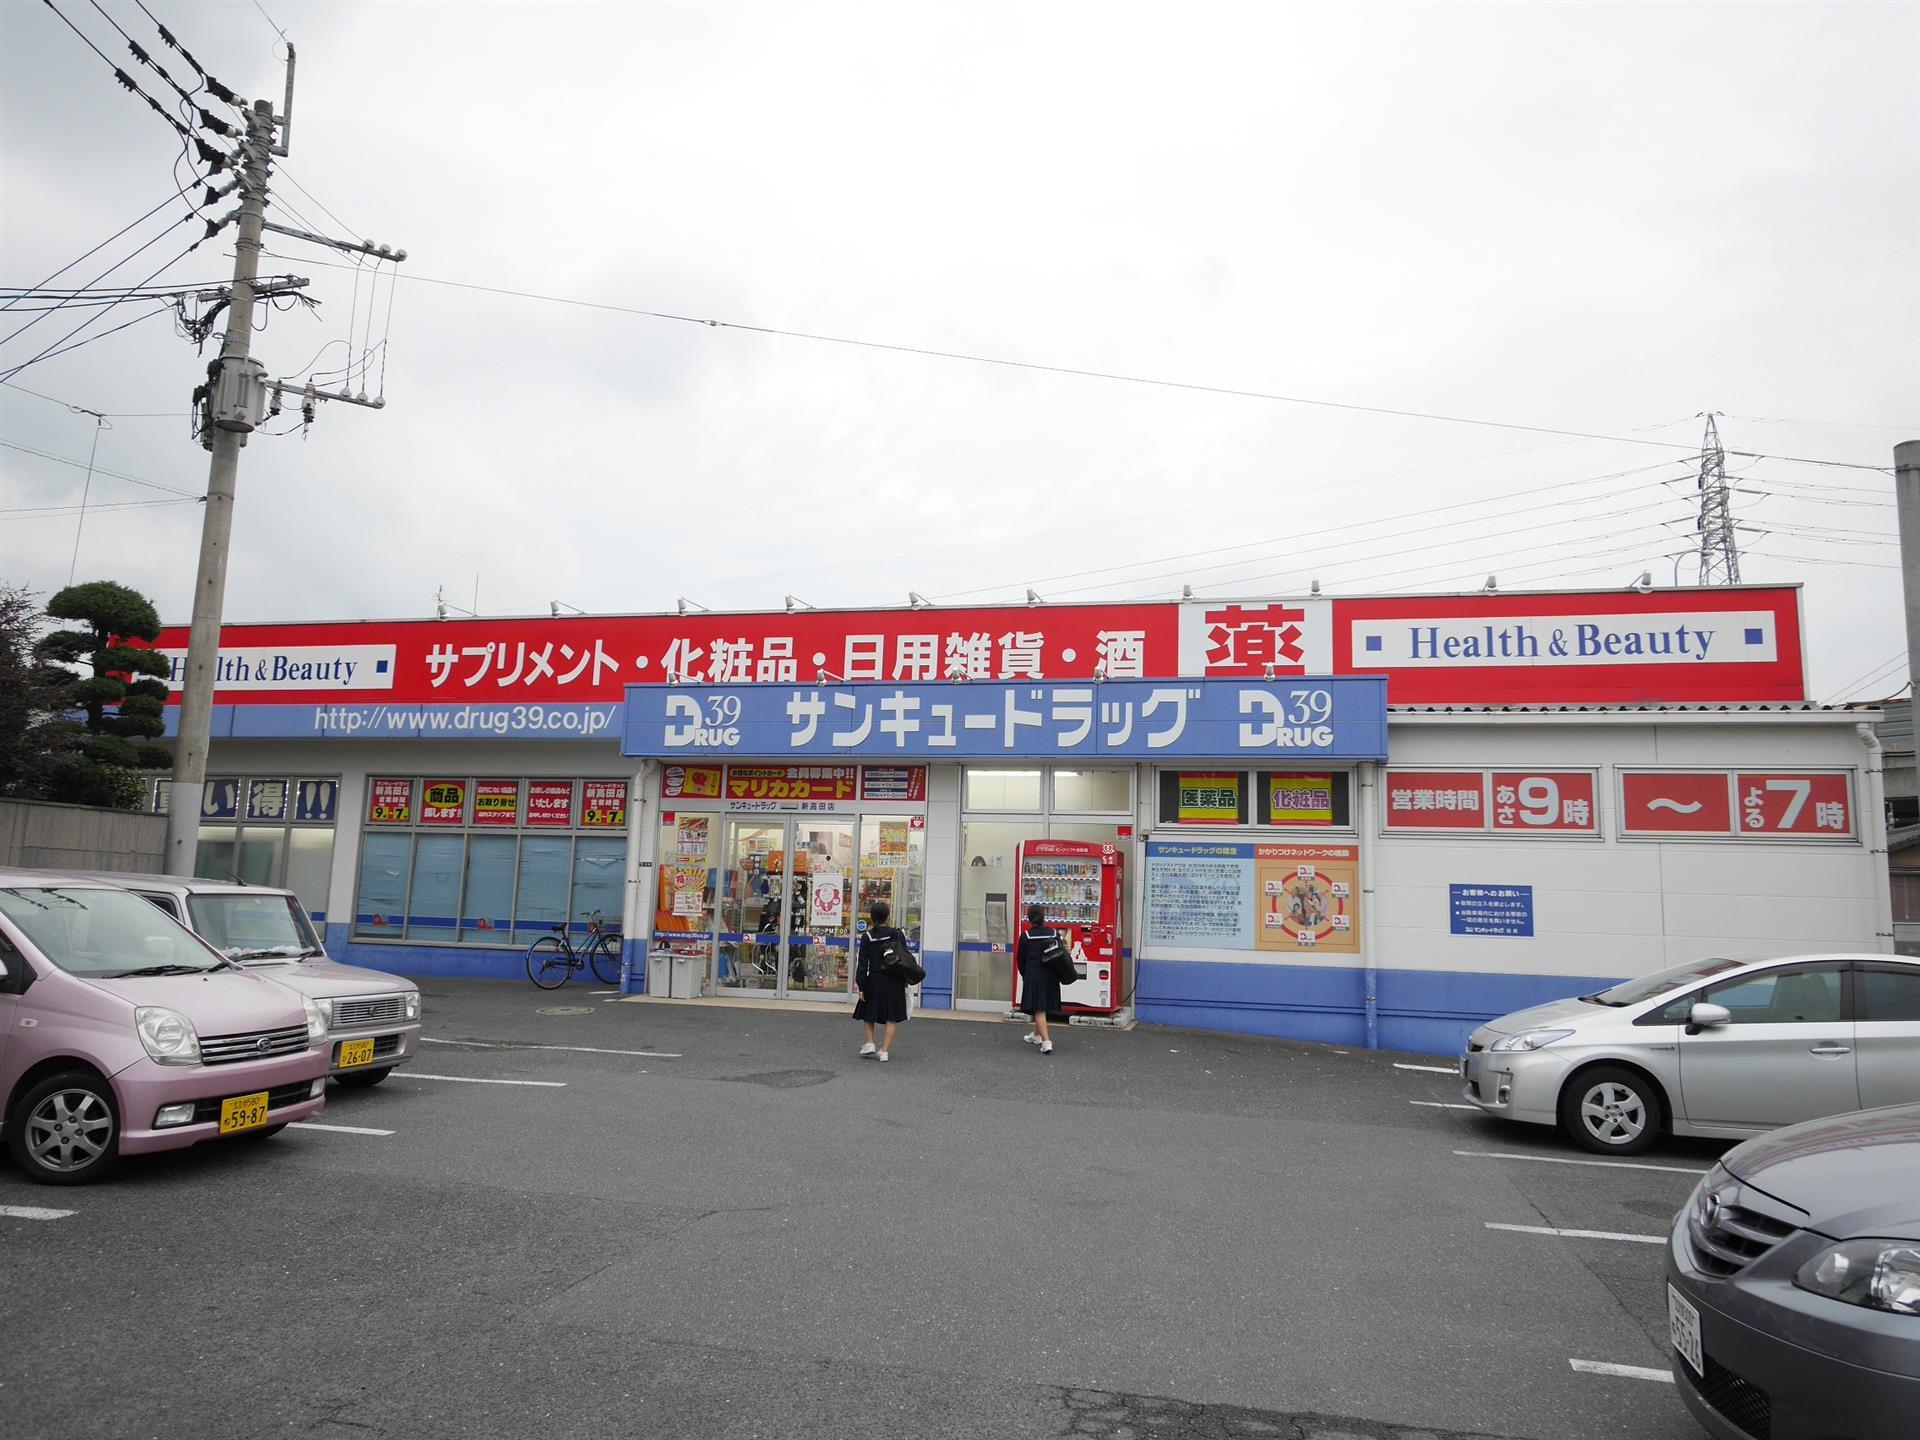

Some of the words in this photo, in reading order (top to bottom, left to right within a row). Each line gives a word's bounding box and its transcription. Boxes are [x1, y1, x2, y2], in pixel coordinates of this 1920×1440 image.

[1204, 603, 1305, 676] 薬
[168, 656, 250, 682] Hlth
[271, 655, 358, 686] Beauty
[314, 705, 616, 735] http://www.drug39.co.jp/
[786, 688, 1201, 748] サンキュードラッグ
[430, 787, 459, 803] 商品
[728, 779, 854, 799] マリカカード
[1180, 787, 1237, 808] 医薬品
[1273, 788, 1331, 809] 化粧品
[530, 798, 569, 808] いたします
[730, 802, 777, 810] サンキュードラッグ
[1391, 789, 1480, 812] 営業時間
[231, 1106, 265, 1128] 59-87
